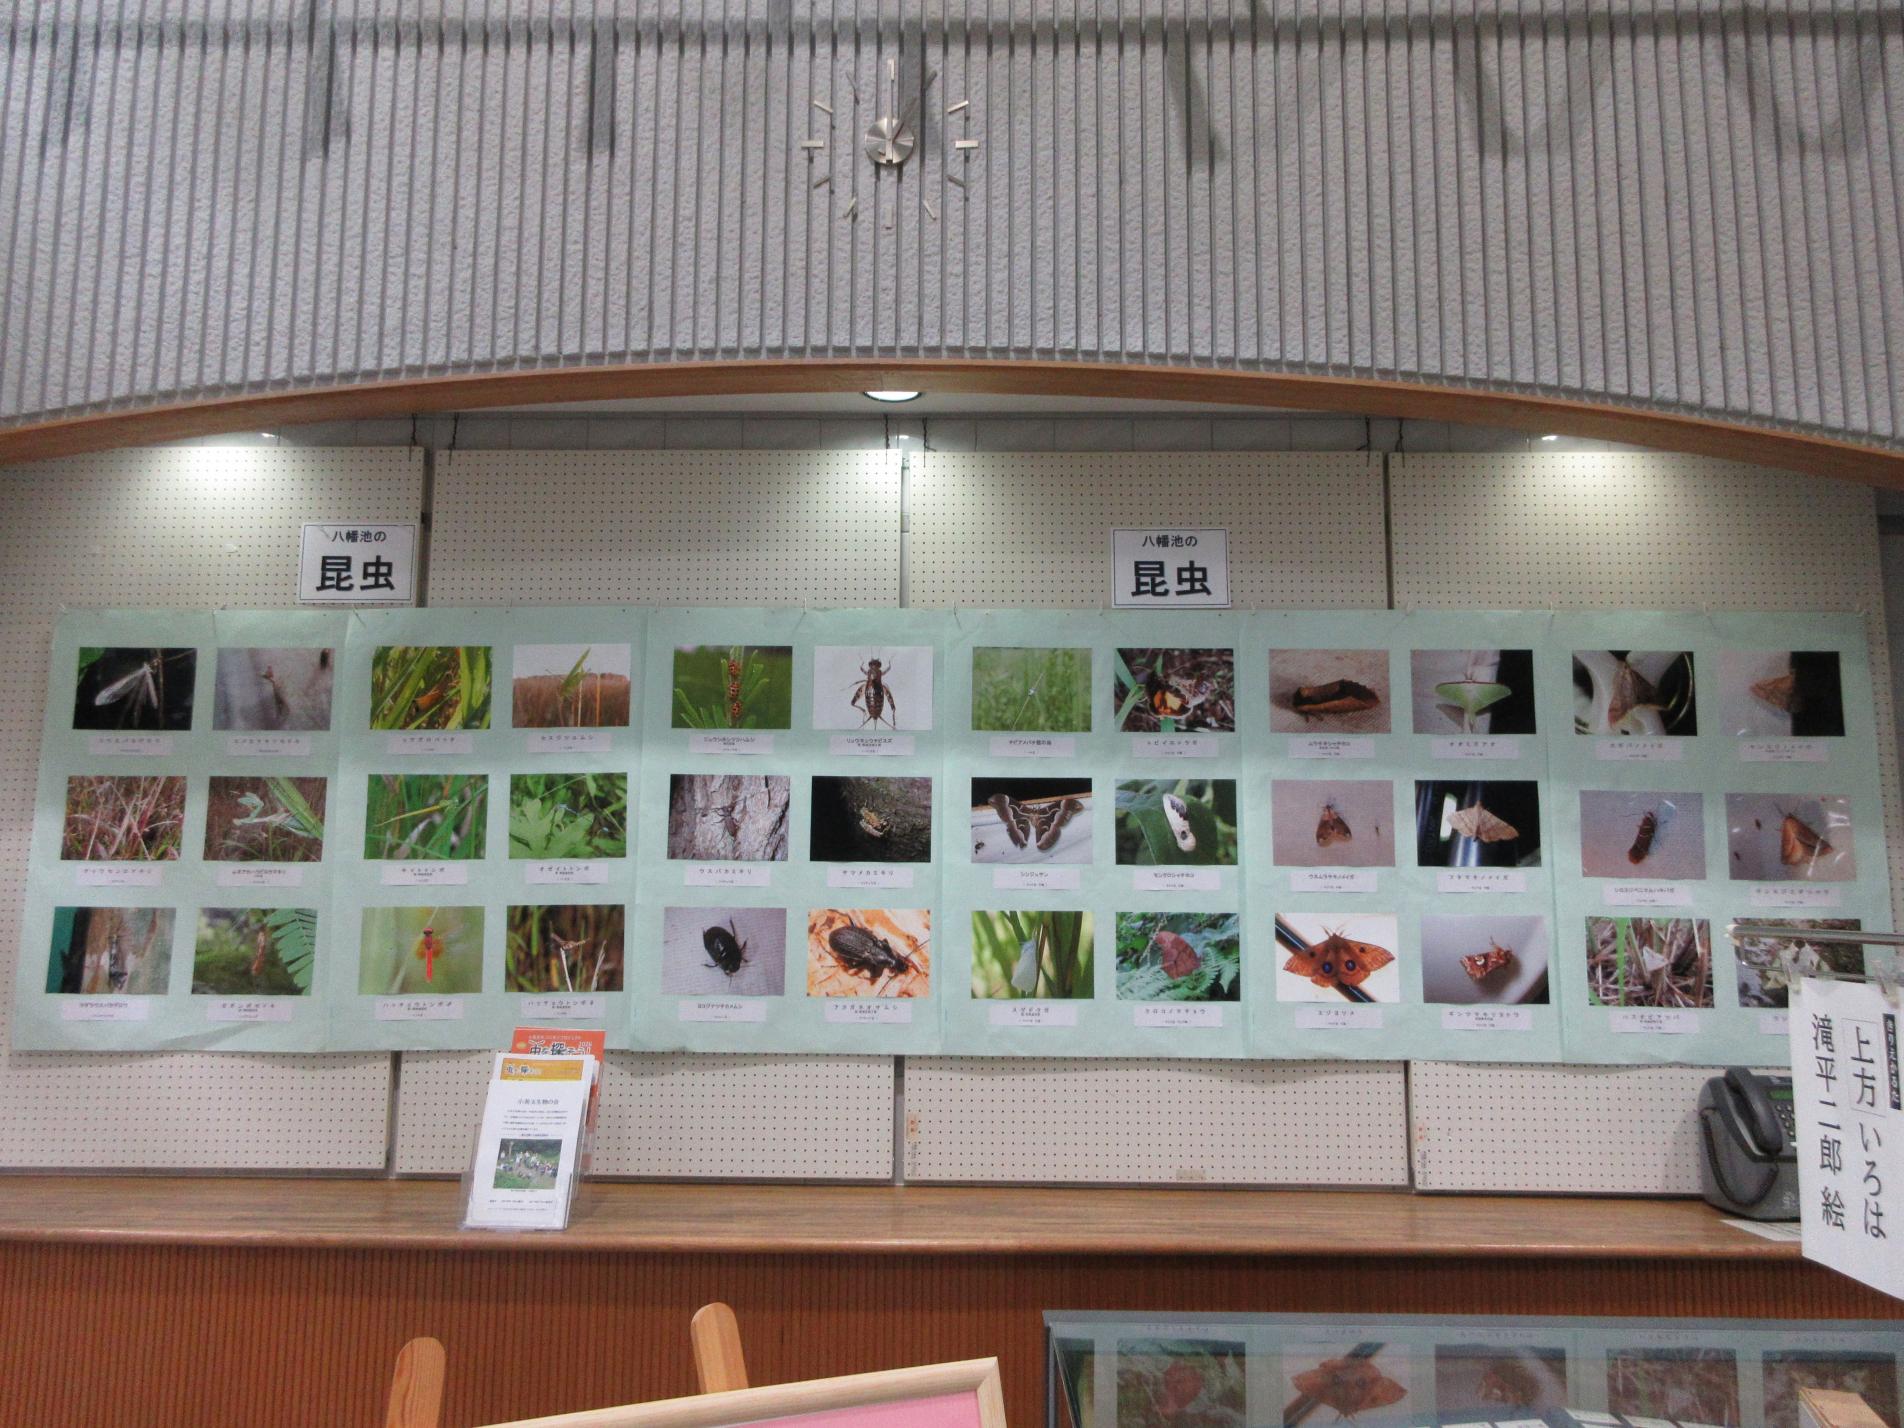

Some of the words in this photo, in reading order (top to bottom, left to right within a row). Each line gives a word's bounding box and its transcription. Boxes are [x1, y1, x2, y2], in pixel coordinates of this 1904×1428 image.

[331, 530, 387, 543] 八幡池の
[1142, 535, 1198, 548] 八幡池の
[316, 555, 395, 591] 昆虫
[1131, 560, 1212, 597] 昆虫
[1811, 1013, 1843, 1176] 滝平二郎
[1821, 1186, 1846, 1232] 絵
